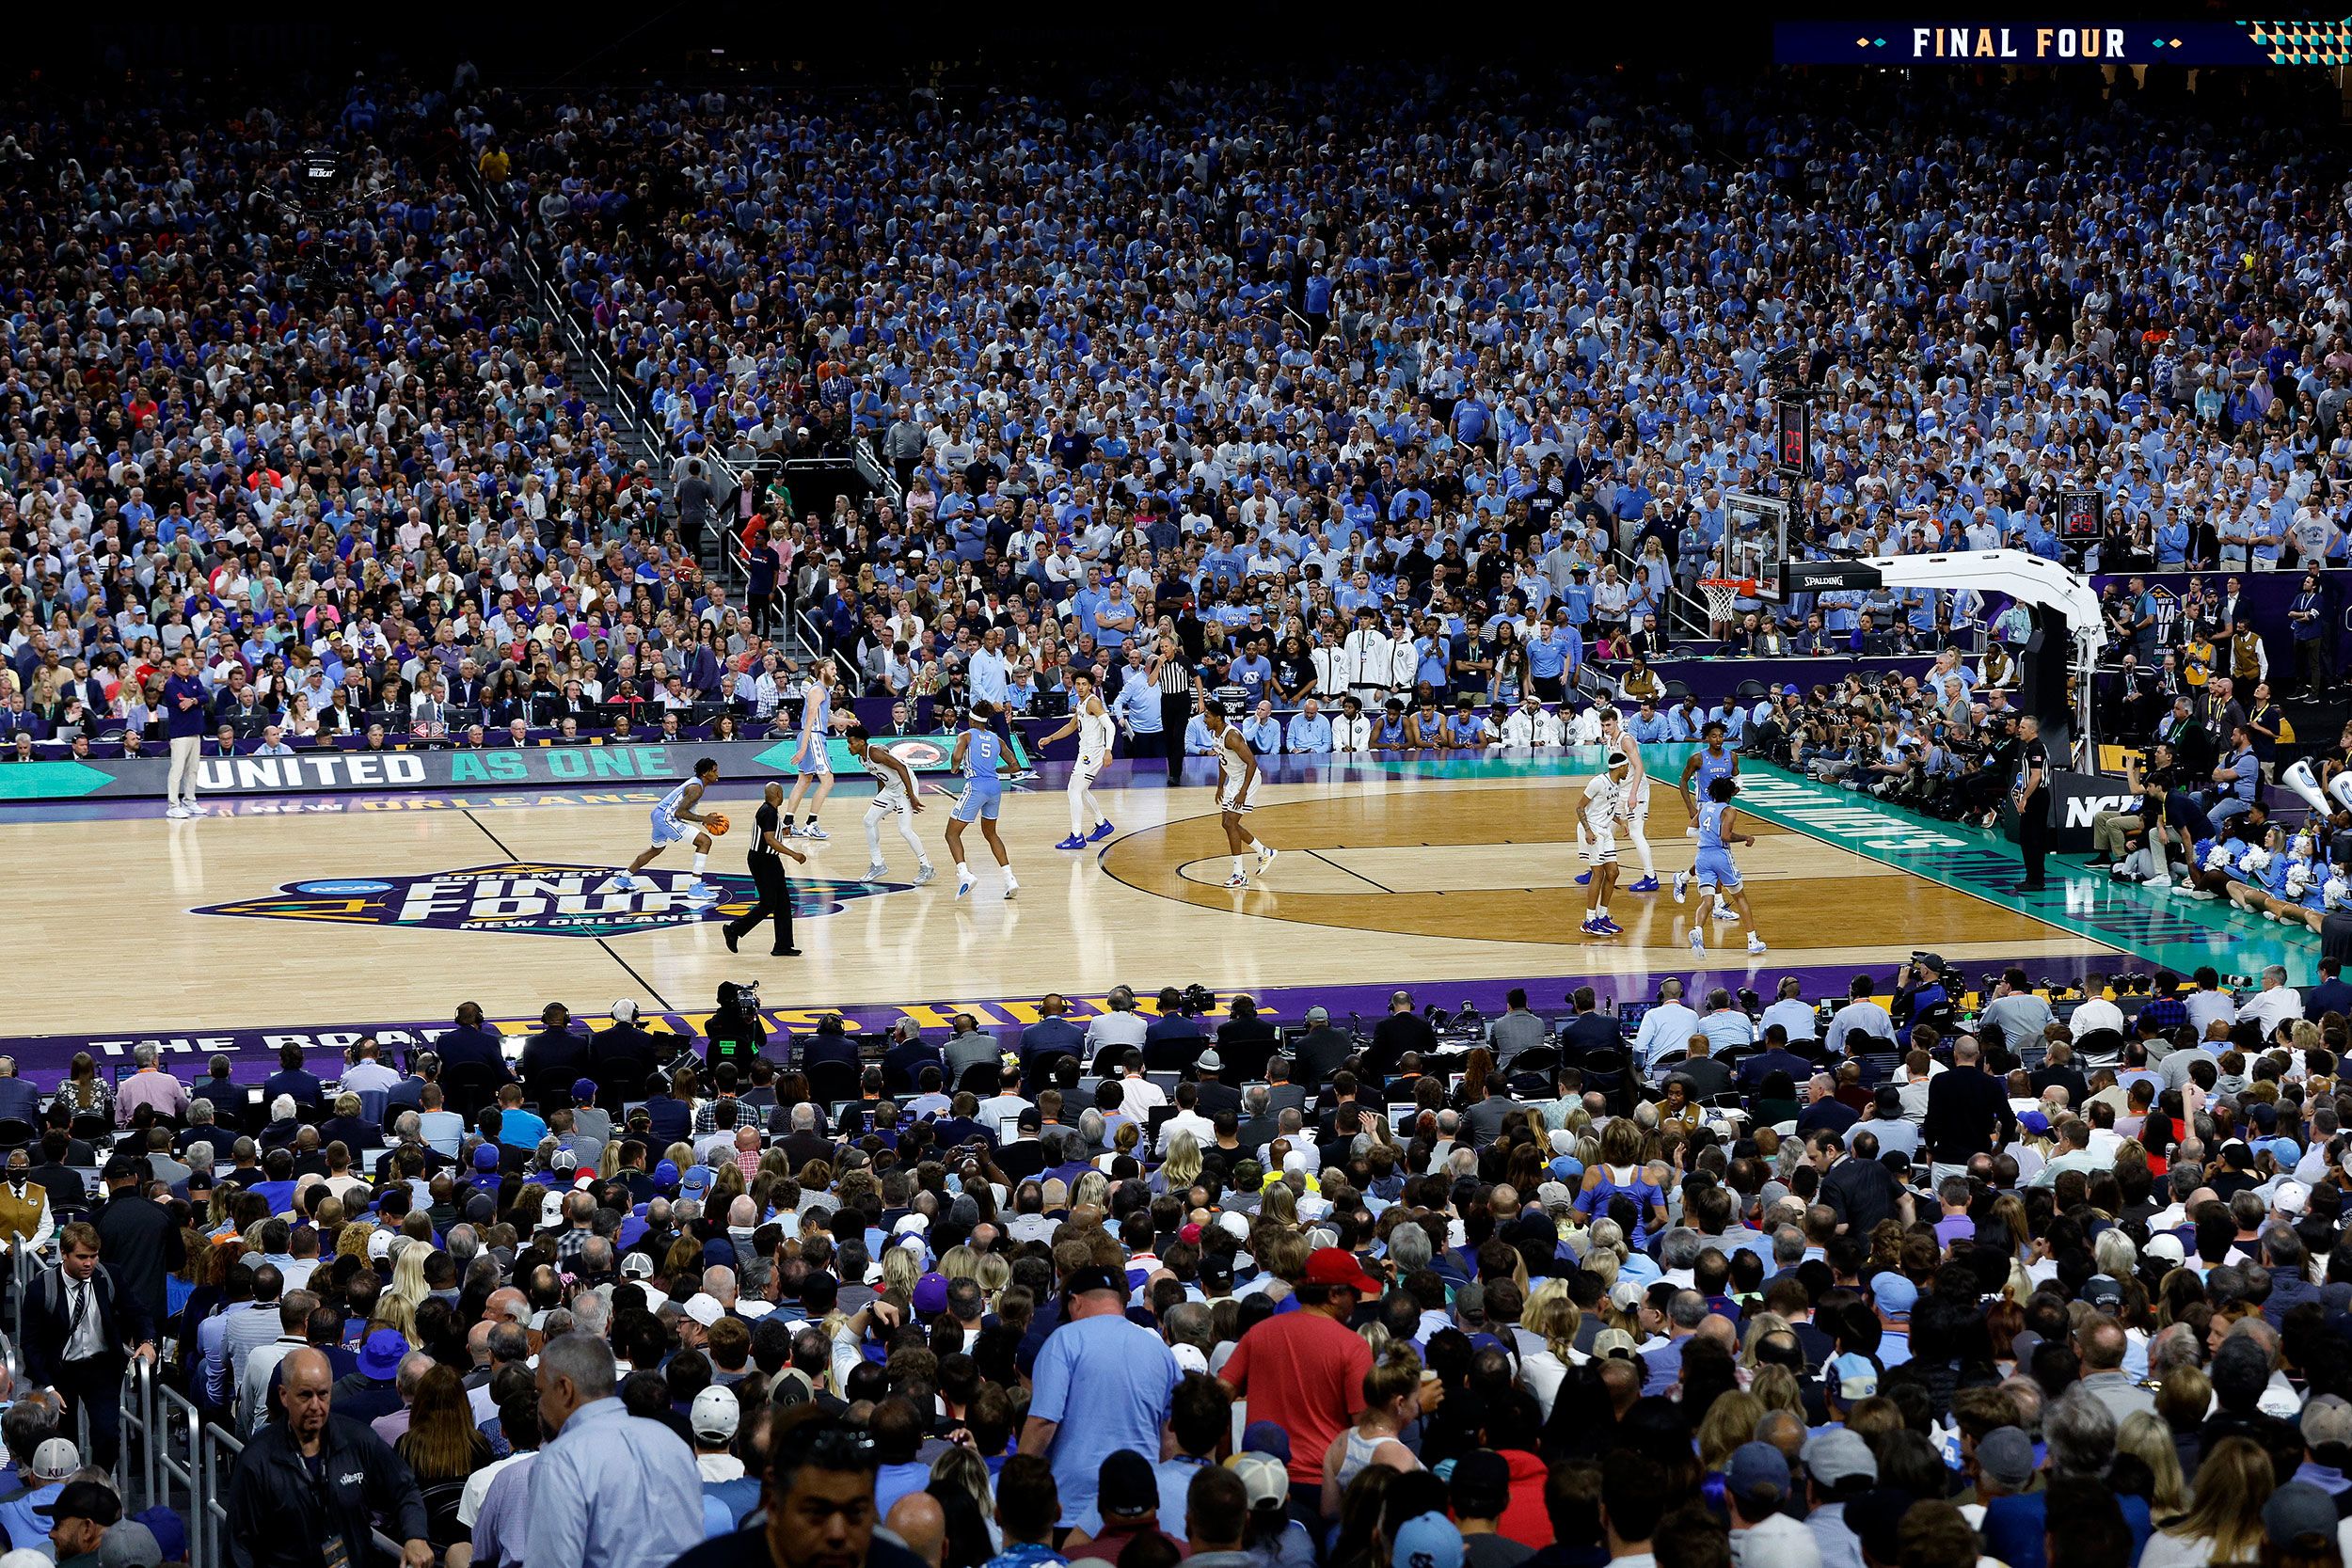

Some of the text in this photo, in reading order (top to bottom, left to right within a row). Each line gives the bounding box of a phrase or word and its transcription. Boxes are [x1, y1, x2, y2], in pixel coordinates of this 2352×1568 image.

[1913, 28, 2125, 57] FINAL FOUR
[1786, 430, 1802, 465] 23
[1804, 575, 1844, 587] SPALDING
[980, 742, 992, 758] 5
[196, 747, 674, 789] UNITED AS ONE
[250, 793, 662, 814] NEW ORLEANS
[1702, 816, 1712, 832] 4
[1772, 806, 1969, 850] MEN'S
[309, 884, 392, 894] NCAA
[405, 873, 723, 901] FINAL
[397, 890, 717, 922] FOUR
[459, 913, 704, 930] NEW ORLEANS
[87, 1037, 242, 1056] THE
[48, 1467, 64, 1478] KU
